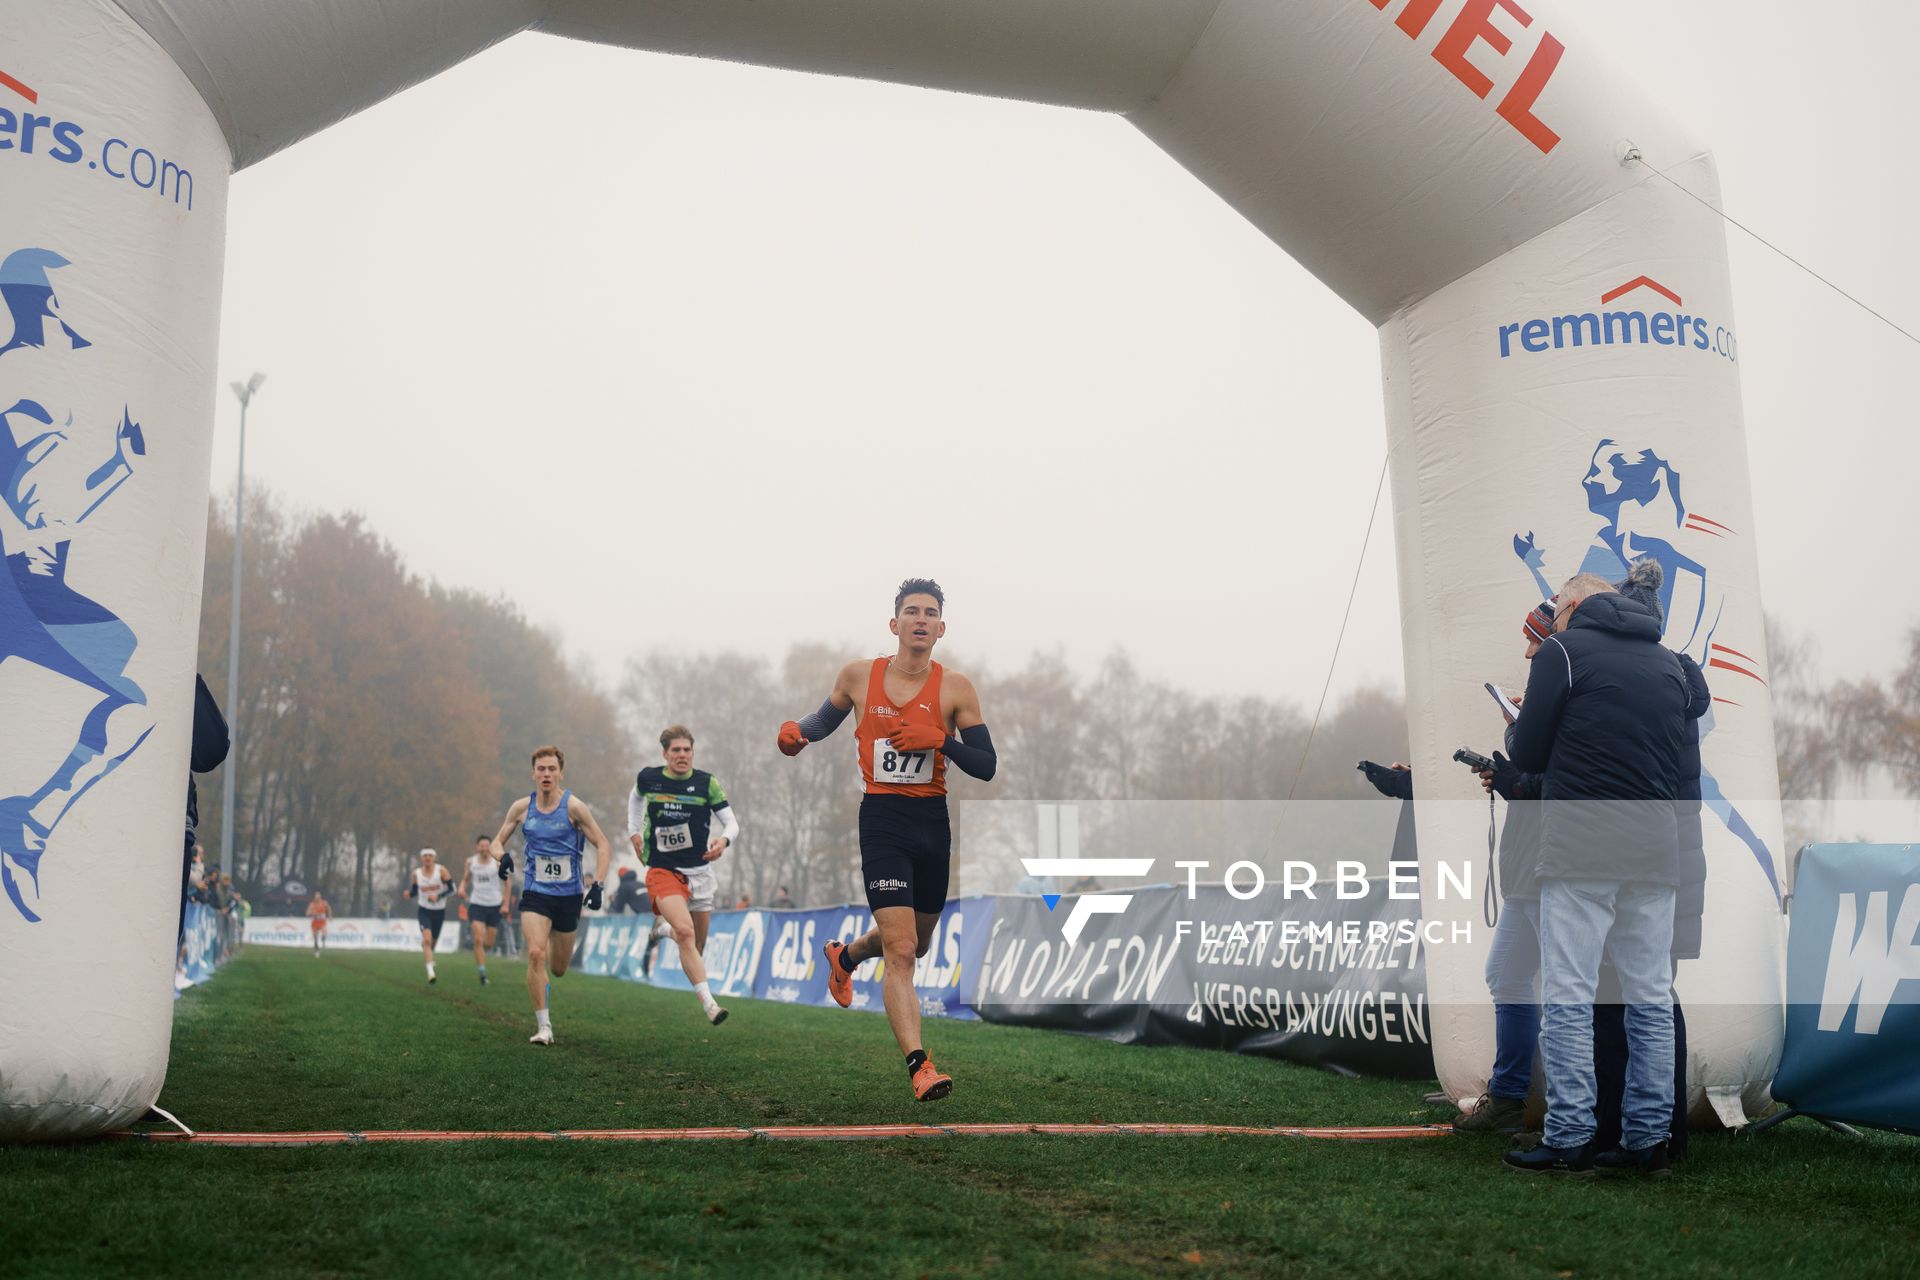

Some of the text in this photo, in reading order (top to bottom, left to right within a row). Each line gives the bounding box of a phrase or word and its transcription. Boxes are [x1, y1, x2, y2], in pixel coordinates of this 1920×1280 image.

[1368, 0, 1566, 155] EL
[1499, 310, 1736, 362] remmers.co
[882, 751, 927, 773] 877
[660, 832, 686, 847] 766
[544, 863, 561, 876] 49
[771, 920, 816, 981] GLS
[991, 935, 1181, 1001] NOVAFON
[1196, 923, 1273, 967] GEGEN
